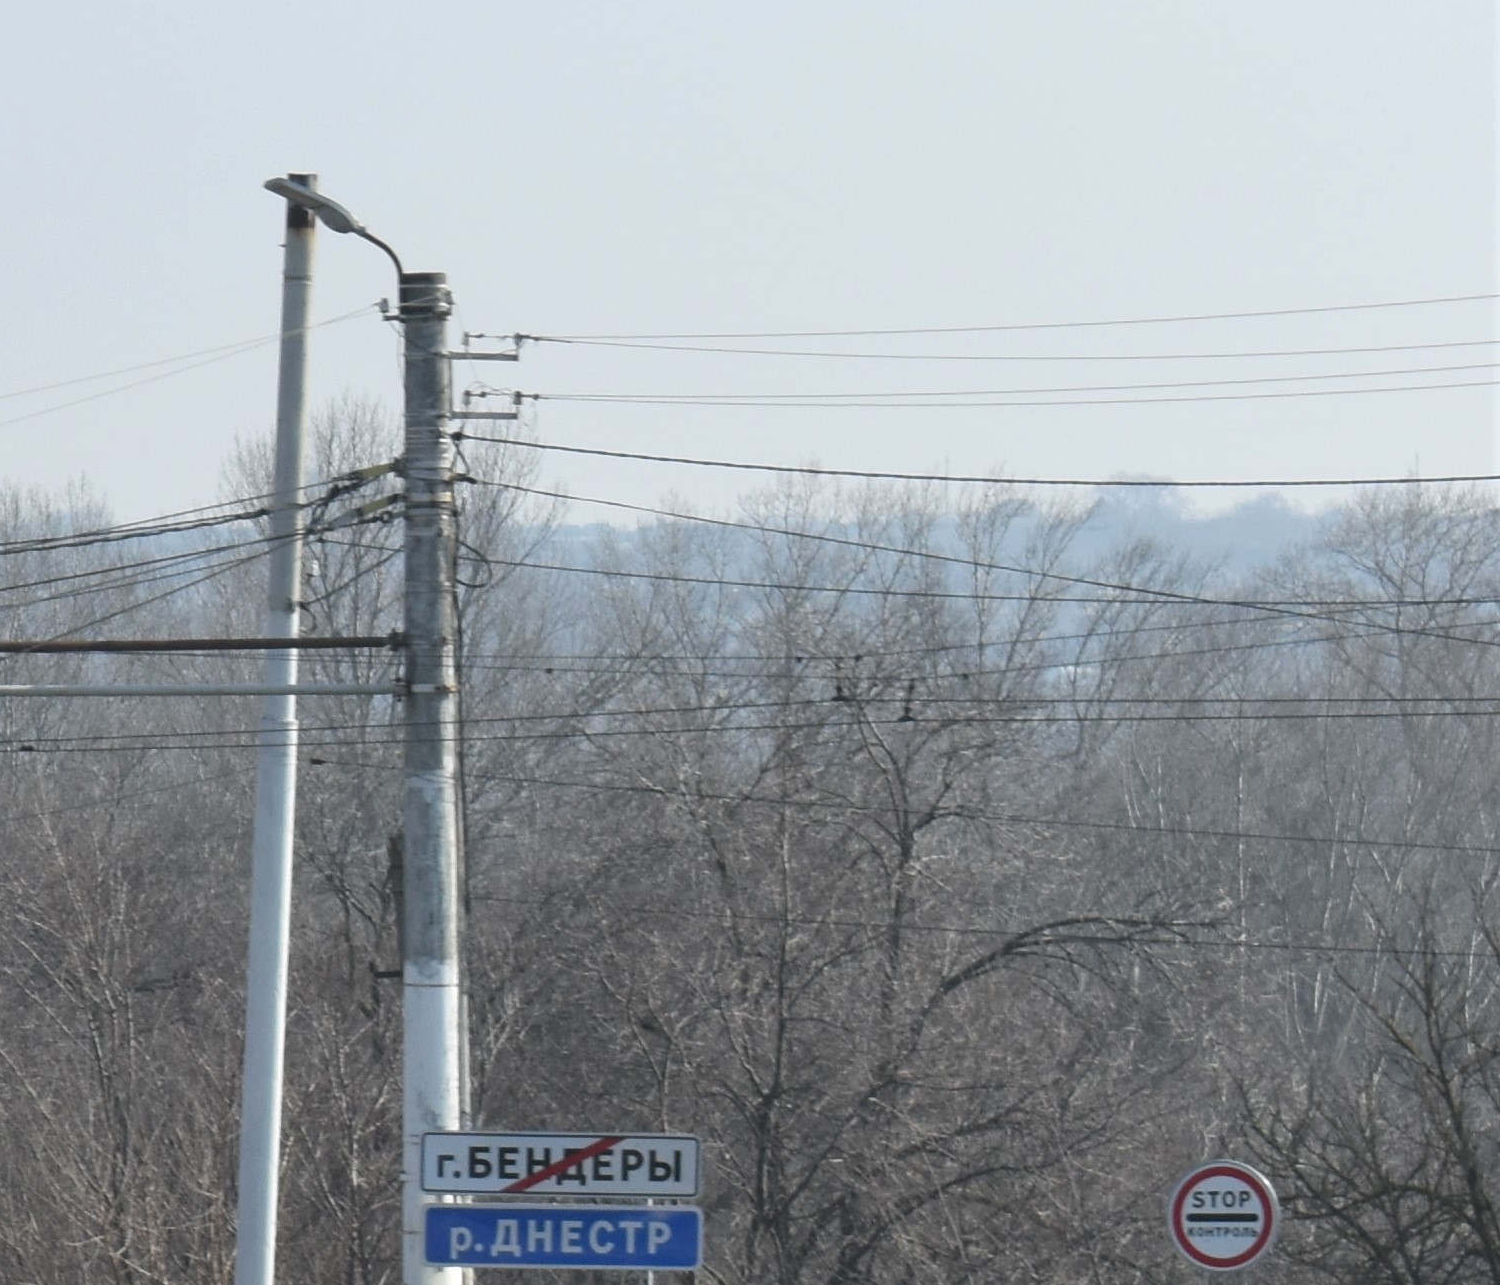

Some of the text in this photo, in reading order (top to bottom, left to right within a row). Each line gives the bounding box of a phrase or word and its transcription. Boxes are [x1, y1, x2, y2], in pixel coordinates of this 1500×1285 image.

[436, 1145, 682, 1186] г.БЕНДЕРЫ
[1191, 1190, 1251, 1208] STOP
[450, 1218, 672, 1260] р.ДНЕСТР
[1188, 1227, 1258, 1237] КОНТРОЛЬ
